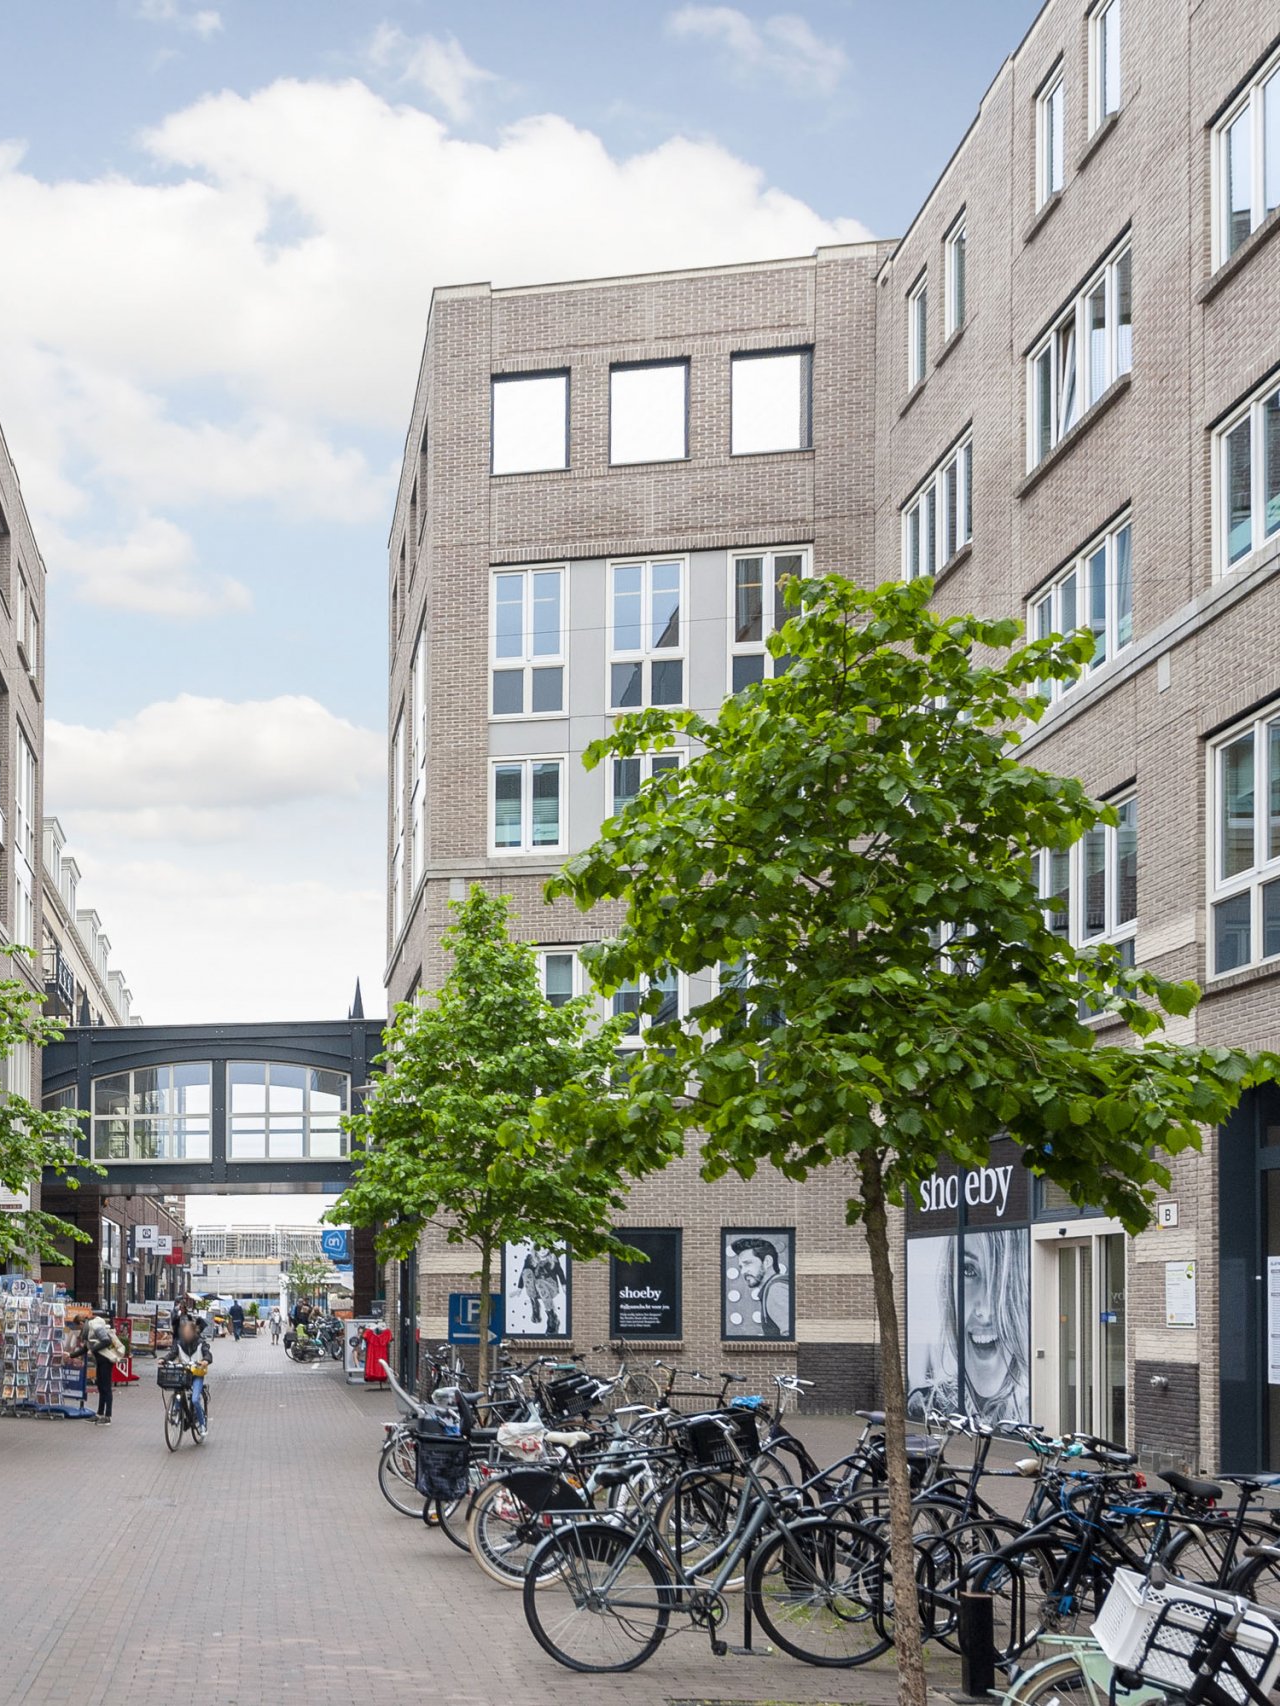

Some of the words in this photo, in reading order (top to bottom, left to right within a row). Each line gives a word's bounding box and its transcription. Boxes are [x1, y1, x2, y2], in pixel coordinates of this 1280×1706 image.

[920, 1165, 1013, 1217] shoeby
[1164, 1208, 1171, 1221] B
[619, 1286, 662, 1301] shoeby
[467, 1299, 482, 1322] P
